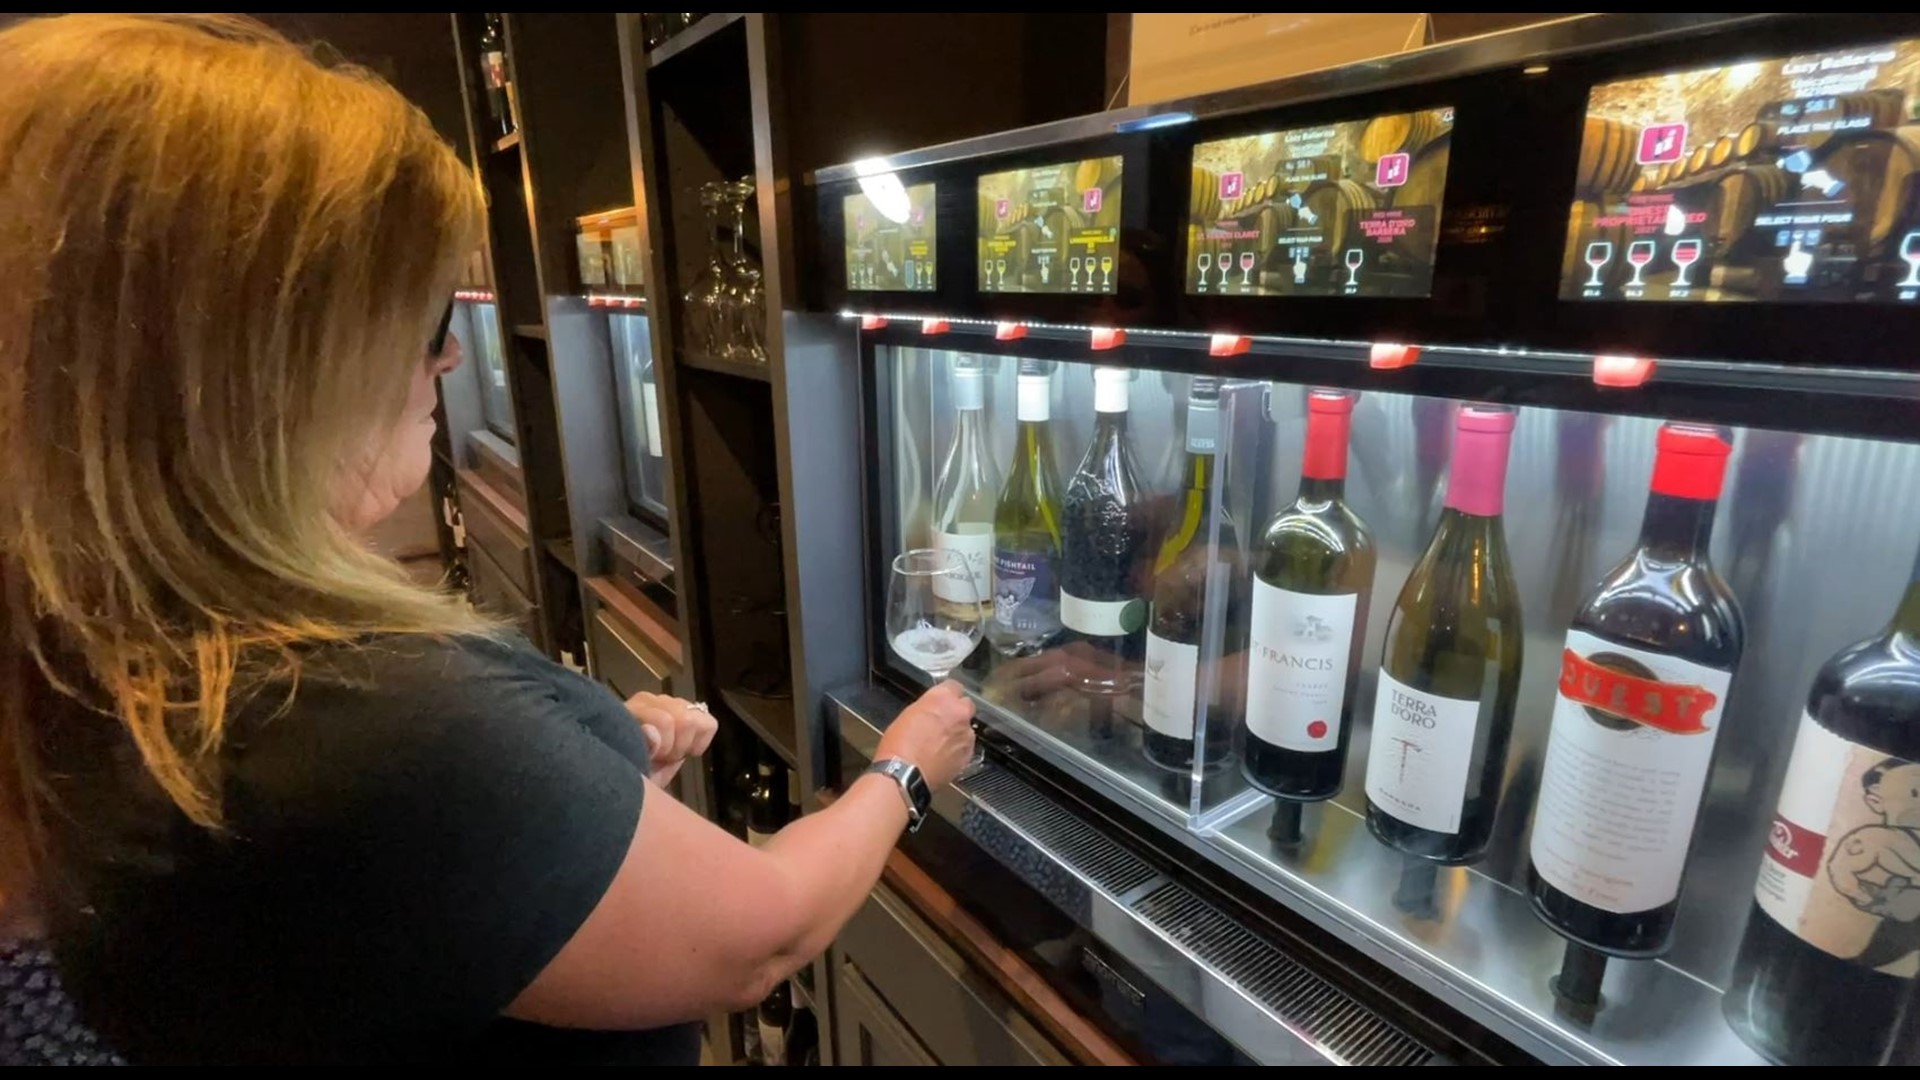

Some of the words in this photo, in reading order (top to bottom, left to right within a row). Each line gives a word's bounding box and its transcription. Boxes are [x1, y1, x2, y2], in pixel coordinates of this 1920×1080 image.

[999, 558, 1036, 571] FISHTAIL
[1262, 646, 1334, 672] FRANCIS
[1391, 688, 1437, 718] TERRA
[1391, 702, 1436, 730] D'ORO
